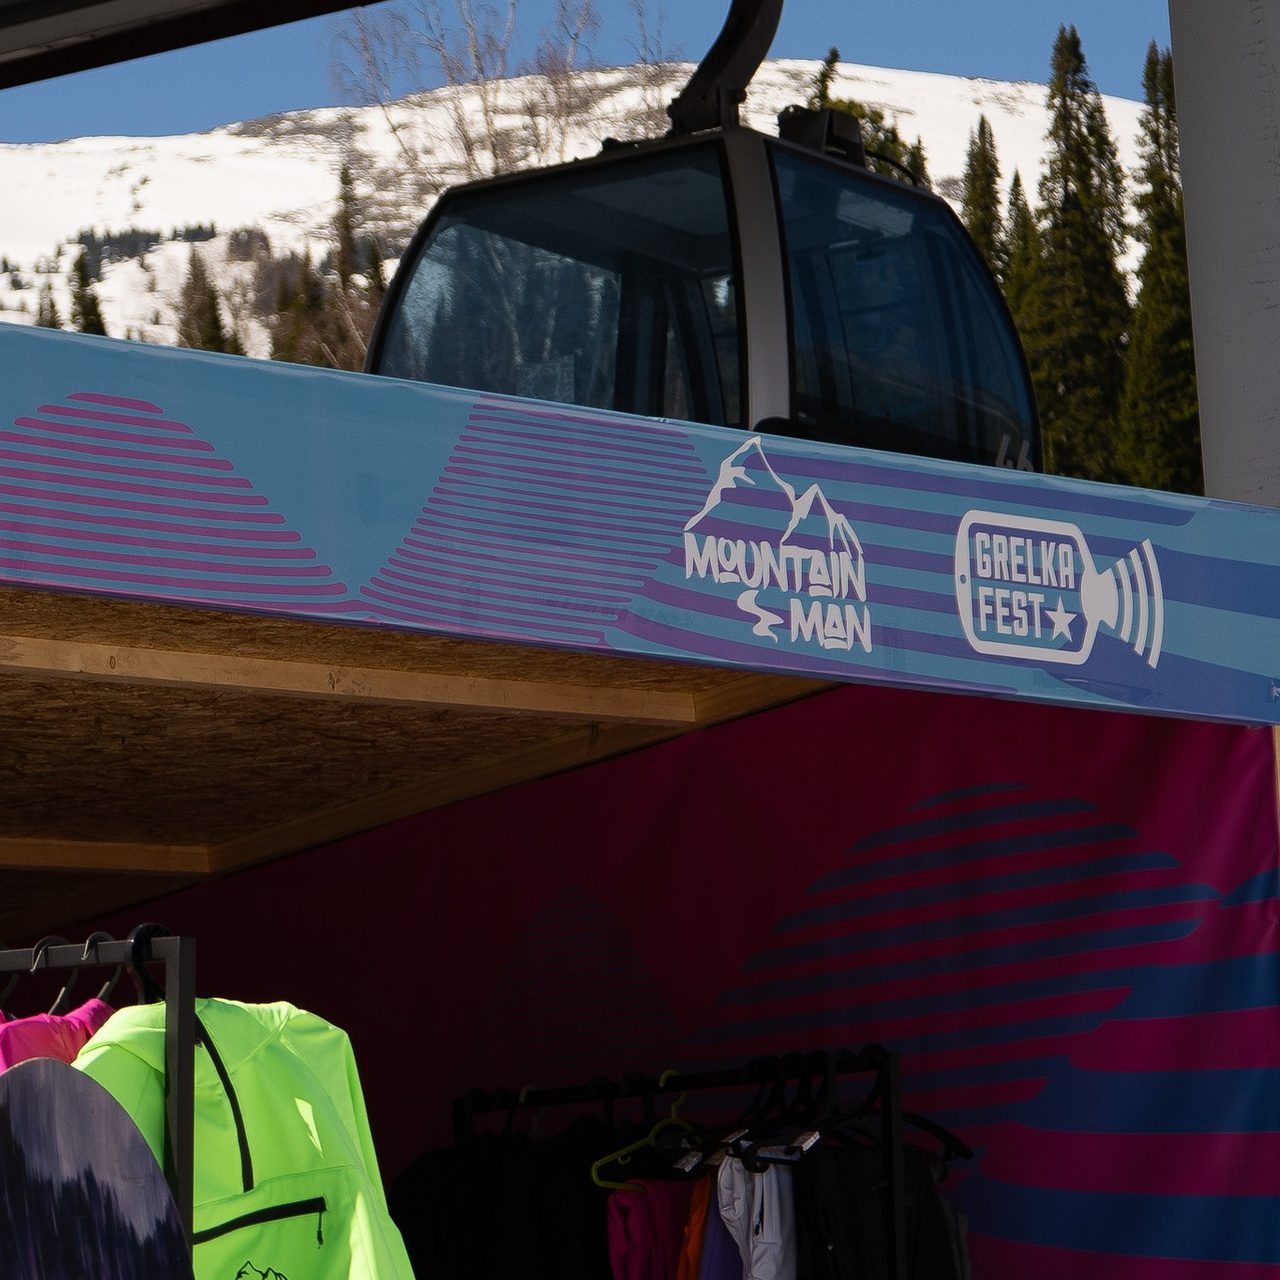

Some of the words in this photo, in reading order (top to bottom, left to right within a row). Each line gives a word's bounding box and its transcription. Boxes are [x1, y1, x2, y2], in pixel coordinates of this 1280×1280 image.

[684, 532, 867, 602] MOUNTAIN
[975, 532, 1075, 589] GRELKA
[790, 598, 872, 653] MAN
[978, 586, 1045, 638] FEST
